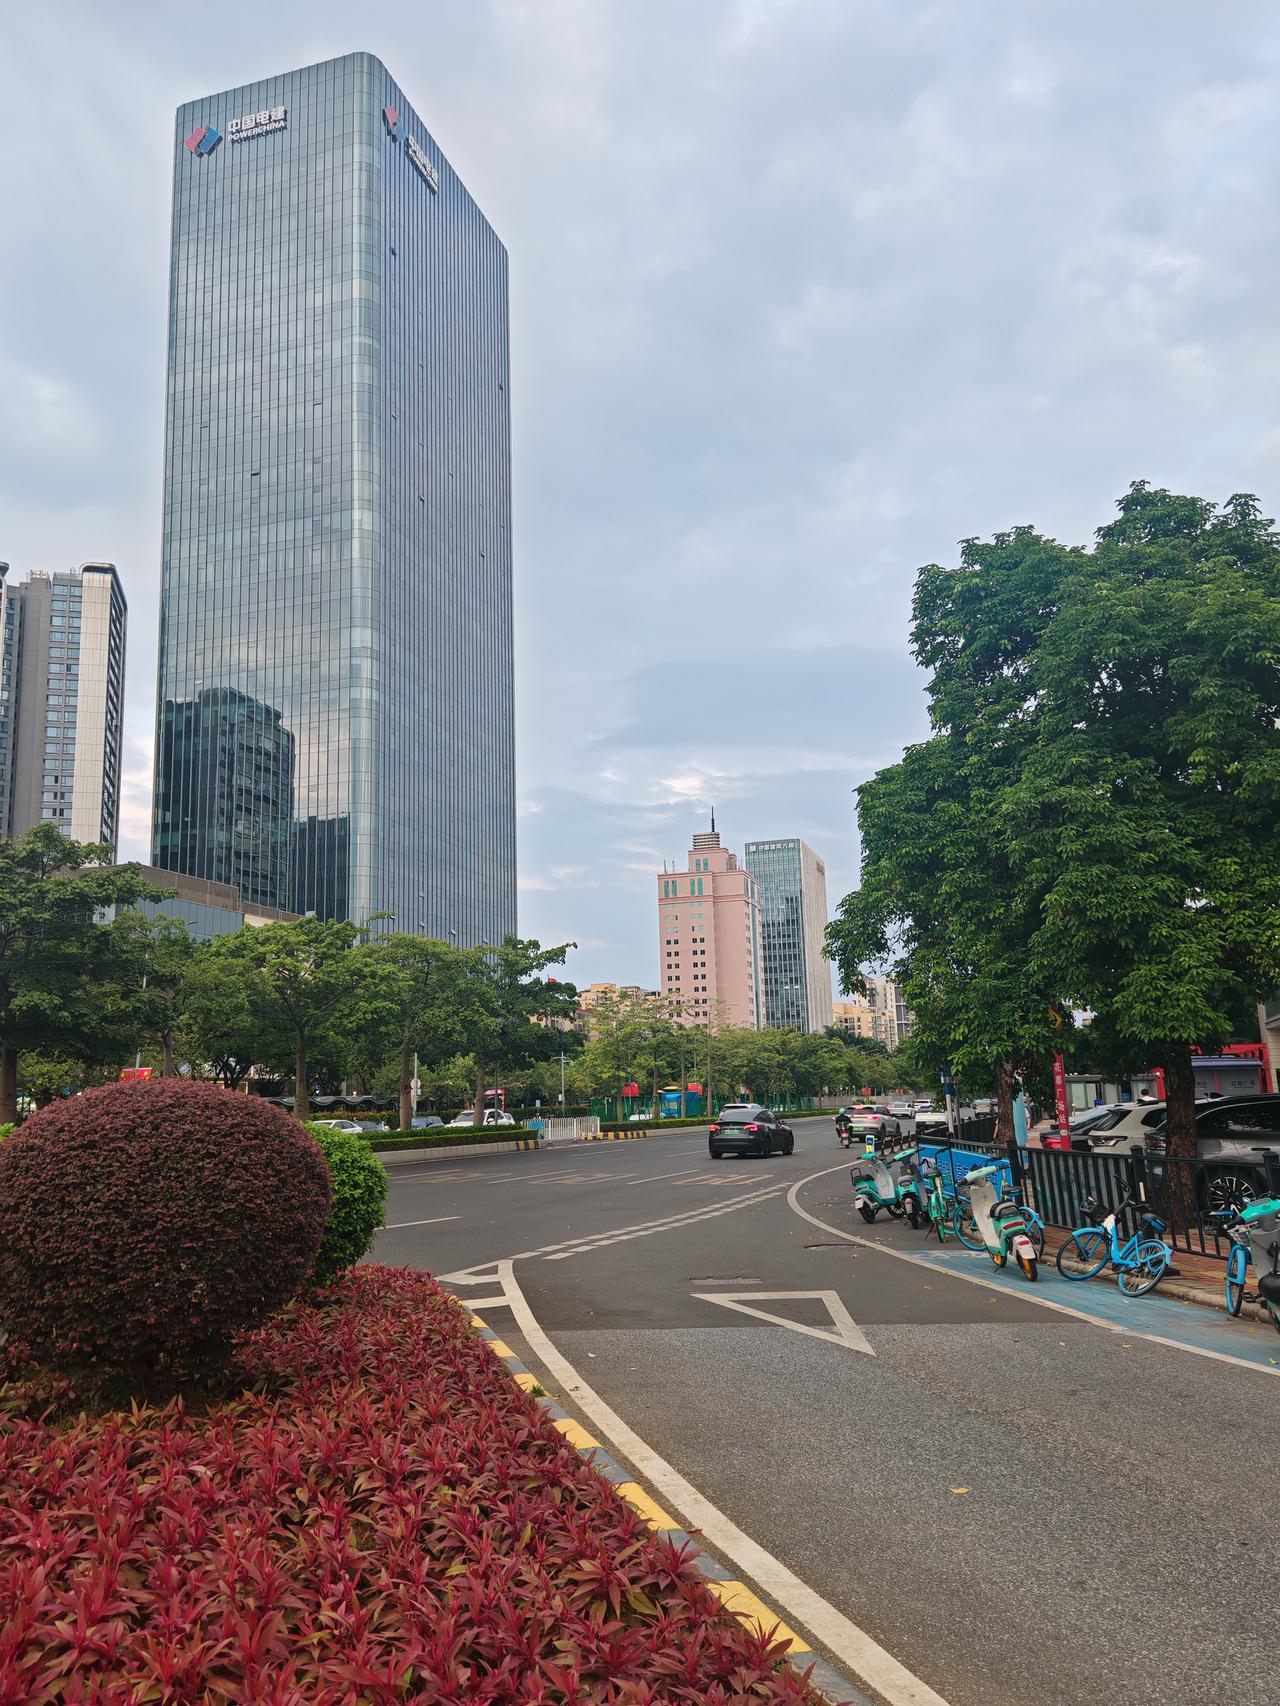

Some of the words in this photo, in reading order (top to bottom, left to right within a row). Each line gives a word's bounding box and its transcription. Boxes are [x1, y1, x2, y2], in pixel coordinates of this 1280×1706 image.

[228, 105, 285, 133] 中国电建
[228, 120, 285, 141] POWERCHINA
